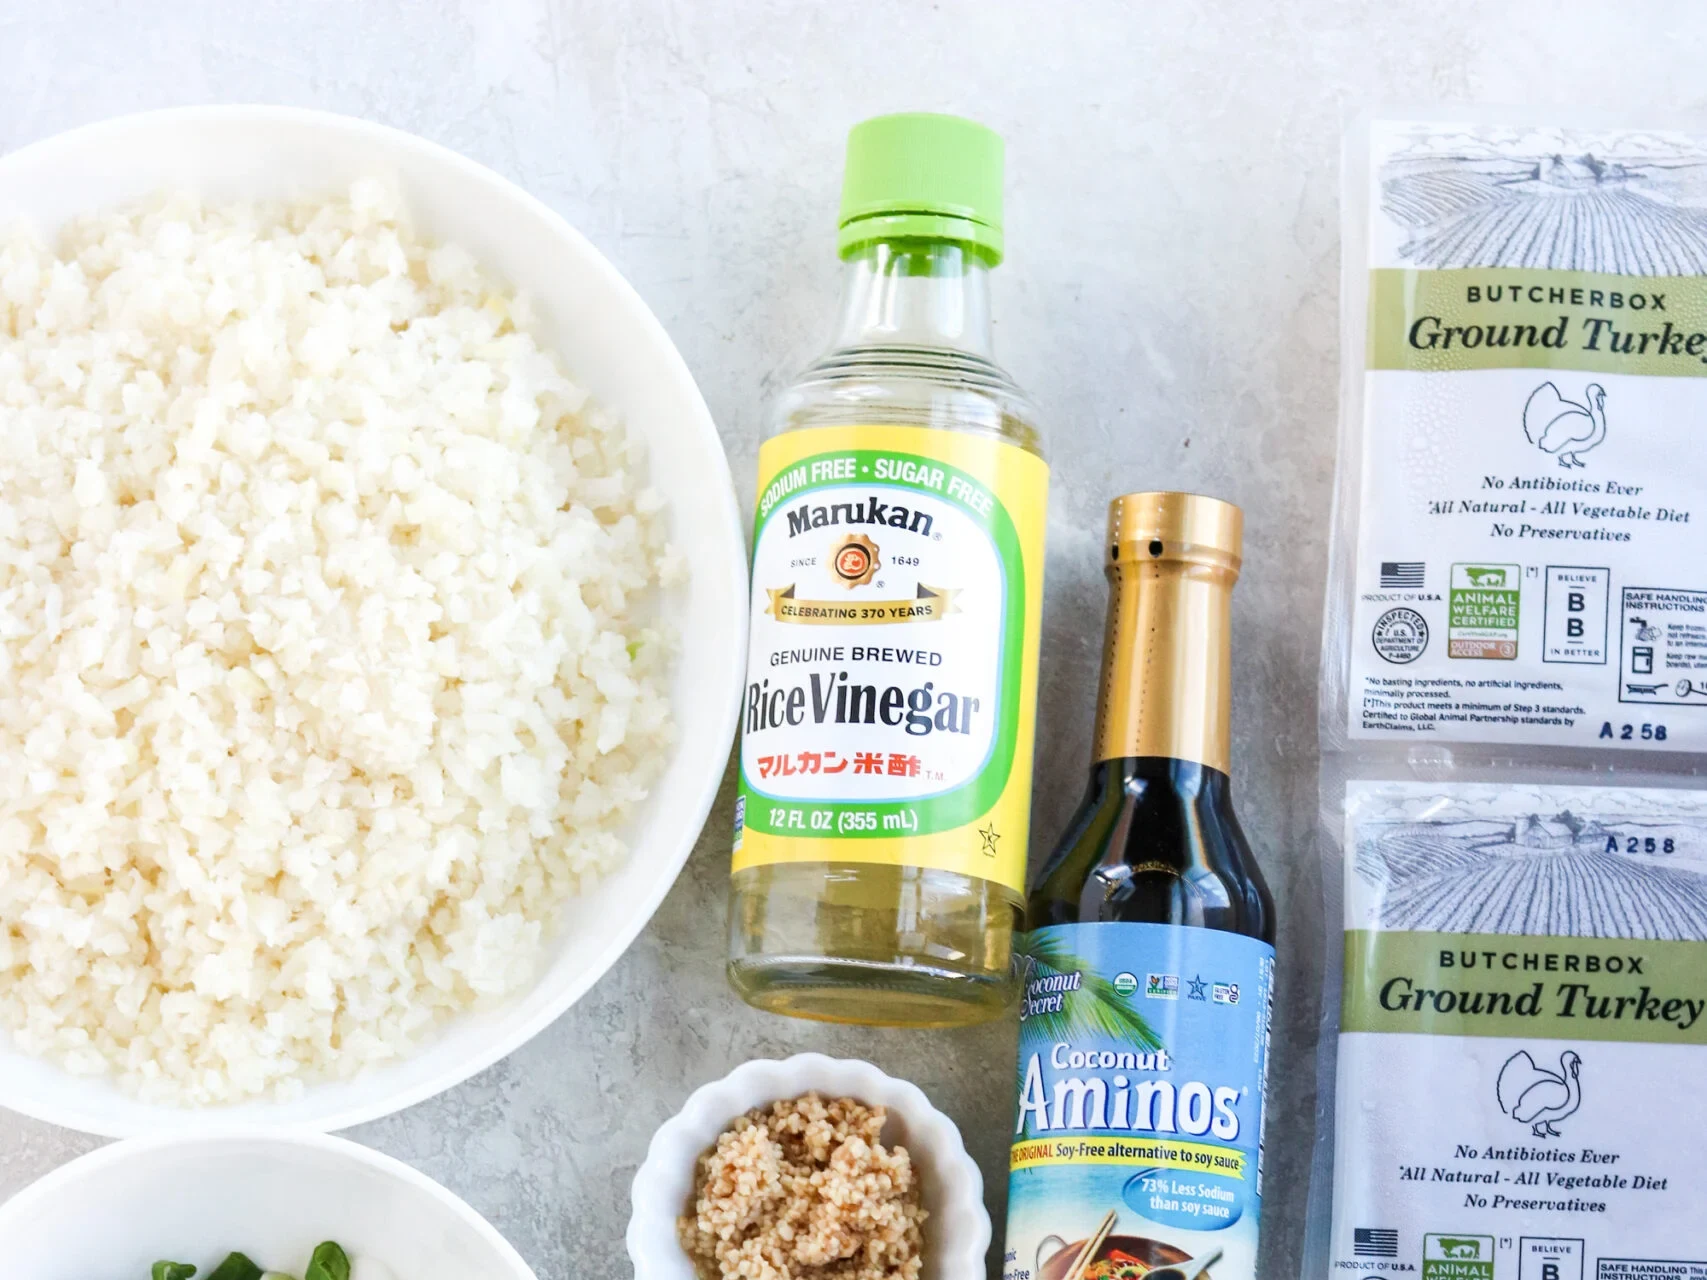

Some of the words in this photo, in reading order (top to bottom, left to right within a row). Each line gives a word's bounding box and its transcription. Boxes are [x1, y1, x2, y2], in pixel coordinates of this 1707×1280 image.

[1466, 286, 1666, 311] BUTCHERBOX
[1408, 315, 1569, 350] Ground
[1582, 317, 1707, 364] Turke
[760, 465, 808, 519] SODIUM
[811, 457, 857, 484] FREE
[874, 457, 944, 492] SUGAR
[946, 475, 995, 519] FREE
[1482, 476, 1505, 490] No
[1508, 476, 1601, 494] Antibiotics
[1605, 482, 1643, 497] Ever
[1458, 499, 1527, 514] Natural
[1540, 500, 1567, 515] All
[1572, 501, 1652, 520] Vegetable
[1655, 508, 1691, 524] Diet
[1490, 523, 1514, 538] No
[1518, 524, 1632, 543] Preservatives
[789, 556, 817, 569] SINCE
[891, 555, 920, 567] 1649
[1557, 574, 1598, 583] BELIEVE
[1453, 592, 1517, 605] ANIMAL
[1567, 592, 1586, 613] B
[780, 604, 858, 620] CELEBRATING
[860, 607, 886, 620] 370
[889, 604, 934, 618] YEARS
[1378, 610, 1425, 631] INSPECTED
[1452, 604, 1516, 617] WELFARE
[1452, 616, 1516, 628] CERTIFIED
[1566, 617, 1585, 638] B
[770, 646, 845, 667] GENUINE
[851, 646, 943, 667] BREWED
[1550, 648, 1561, 656] IN
[1564, 649, 1601, 658] BETTER
[746, 678, 806, 735] Rice
[808, 670, 981, 737] Vinegar
[769, 808, 785, 828] 12
[787, 810, 806, 830] FL
[810, 810, 833, 830] OZ
[837, 811, 878, 835] (355
[883, 809, 919, 833] mL)
[1439, 950, 1645, 975] BUTCHERBOX
[1378, 977, 1545, 1017] Ground
[1555, 983, 1706, 1031] Turkey
[1051, 1042, 1171, 1072] Coconut
[1016, 1052, 1241, 1141] Aminos
[1019, 1144, 1054, 1162] ORIGINAL
[1056, 1142, 1105, 1160] Soy-Free
[1107, 1143, 1178, 1161] alternative
[1180, 1149, 1193, 1162] to
[1194, 1152, 1213, 1168] soy
[1214, 1155, 1240, 1170] sauce
[1454, 1144, 1478, 1160] No
[1481, 1145, 1576, 1163] Antibiotics
[1579, 1149, 1620, 1165] Ever
[1430, 1167, 1501, 1185] Natural
[1513, 1171, 1541, 1186] All
[1546, 1171, 1628, 1190] Vegetable
[1631, 1175, 1669, 1191] Diet
[1141, 1177, 1169, 1193] 73%
[1171, 1180, 1197, 1197] Less
[1198, 1183, 1235, 1203] Sodium
[1150, 1195, 1179, 1211] than
[1181, 1200, 1202, 1217] soy
[1202, 1205, 1231, 1219] sauce
[1463, 1193, 1488, 1209] No
[1491, 1194, 1607, 1213] Preservatives
[1531, 1245, 1572, 1254] BELIEVE
[1334, 1260, 1375, 1270] PRODUCT
[1376, 1262, 1390, 1270] OF
[1426, 1263, 1490, 1277] ANIMAL
[1600, 1263, 1629, 1273] SAFE
[1630, 1265, 1688, 1275] HANDLING
